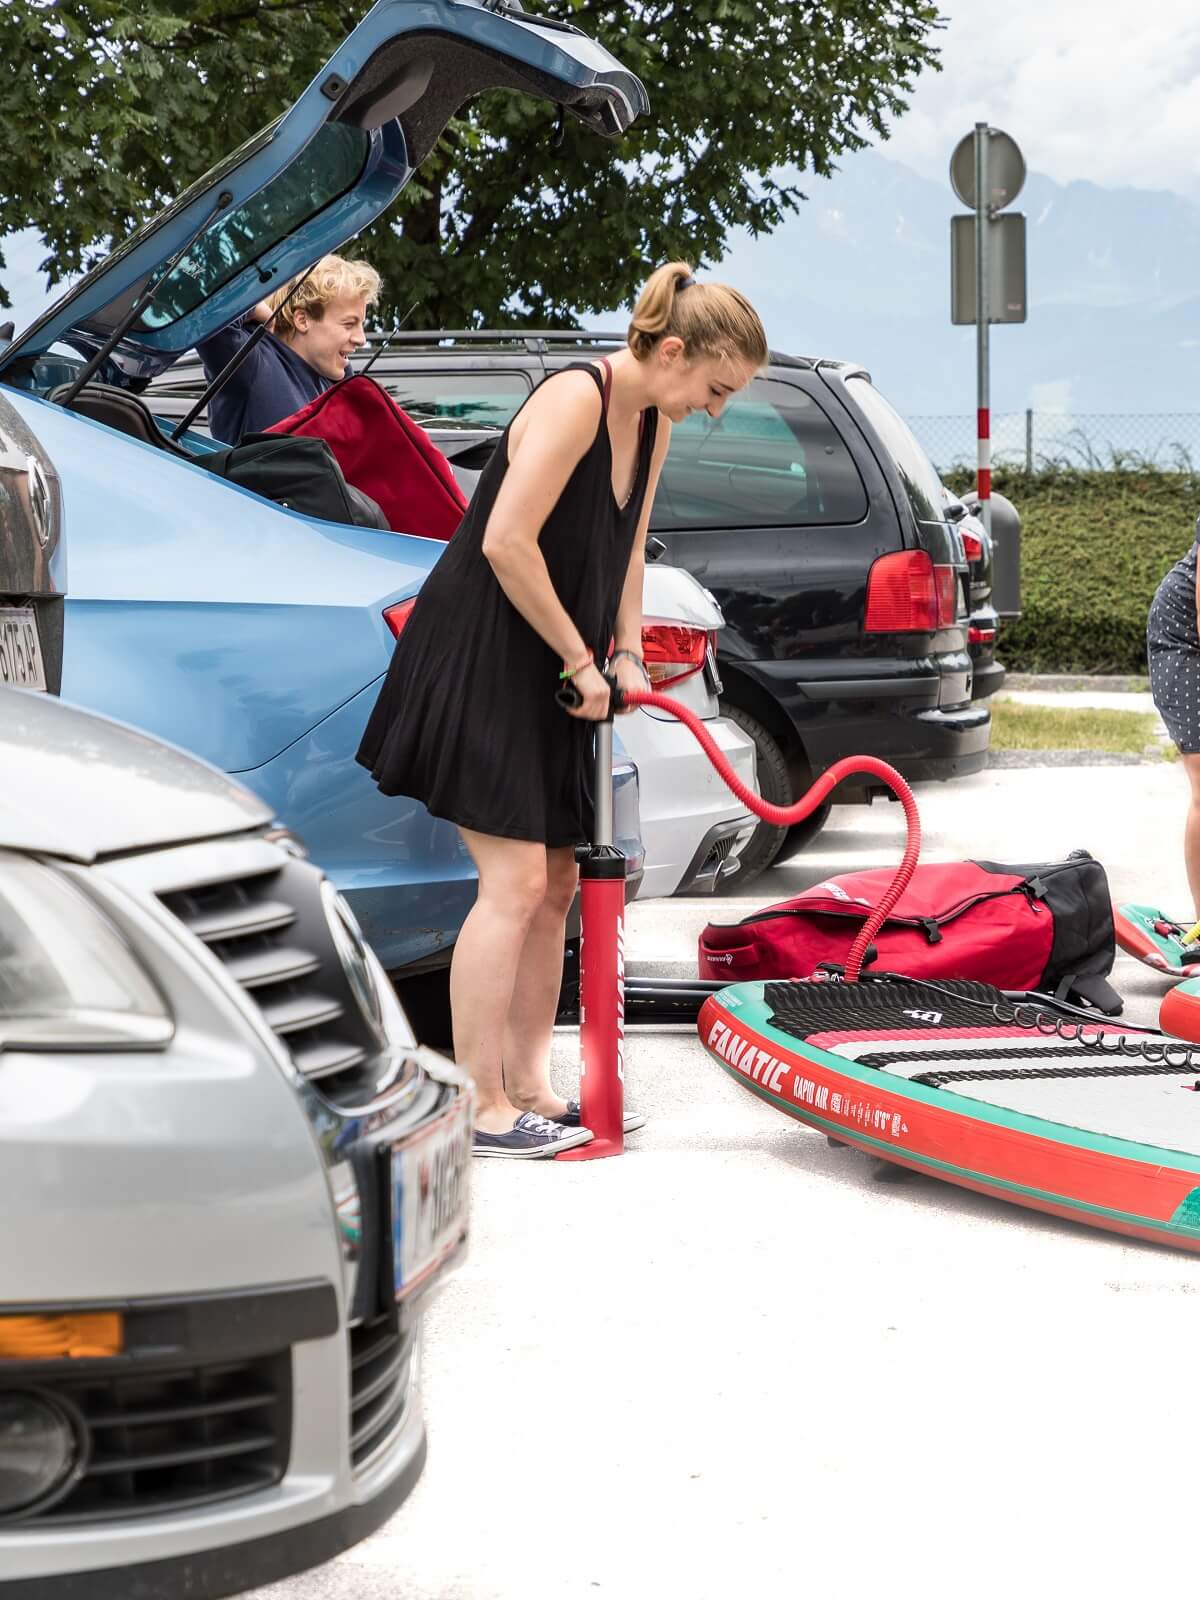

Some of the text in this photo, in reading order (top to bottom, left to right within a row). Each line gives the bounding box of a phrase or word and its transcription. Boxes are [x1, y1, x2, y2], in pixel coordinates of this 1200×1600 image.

[708, 1020, 791, 1093] FANATIC
[793, 1075, 816, 1104] RAPID
[815, 1085, 829, 1111] AIR
